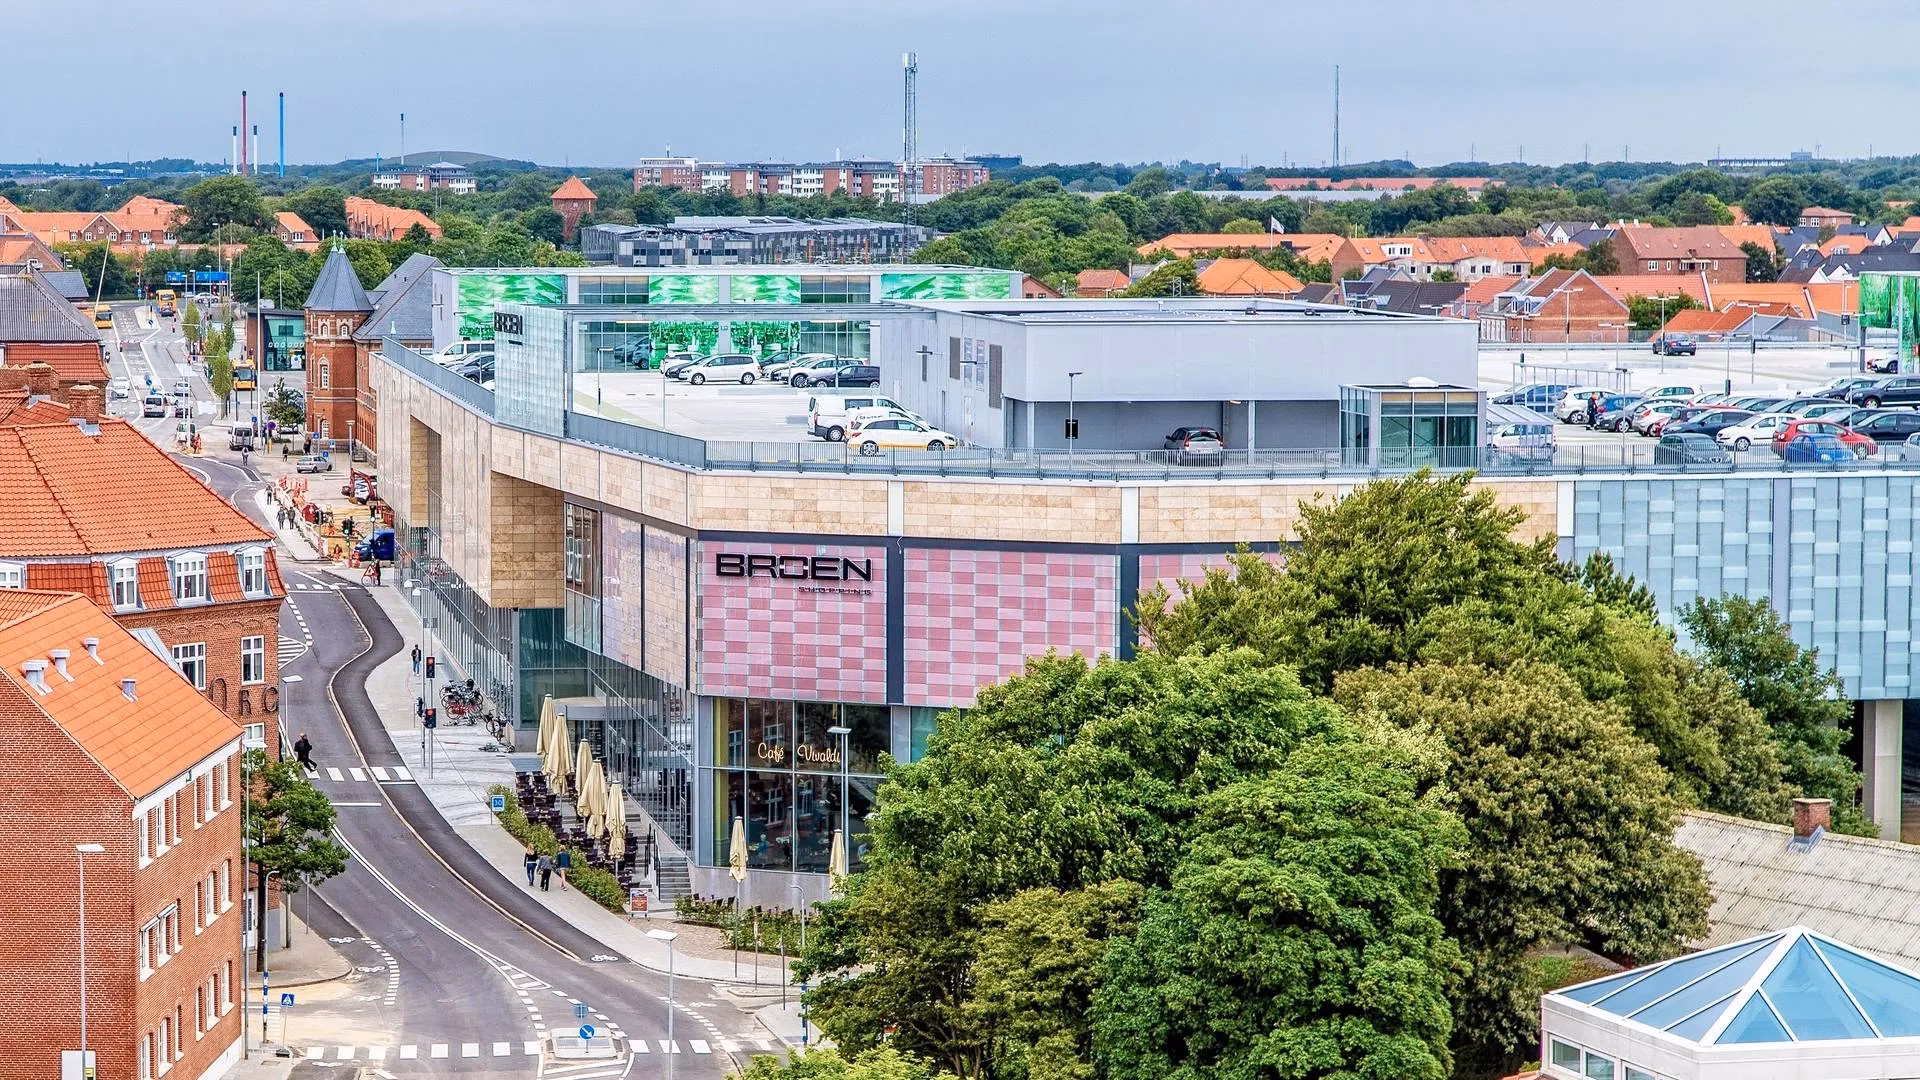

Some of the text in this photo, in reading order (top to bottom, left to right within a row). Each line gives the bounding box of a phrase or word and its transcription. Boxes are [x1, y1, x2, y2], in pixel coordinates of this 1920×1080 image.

[494, 311, 523, 335] BROEN
[716, 553, 873, 581] BROEN
[798, 586, 872, 596] SHOPPING
[757, 742, 841, 763] Café Vivaldi
